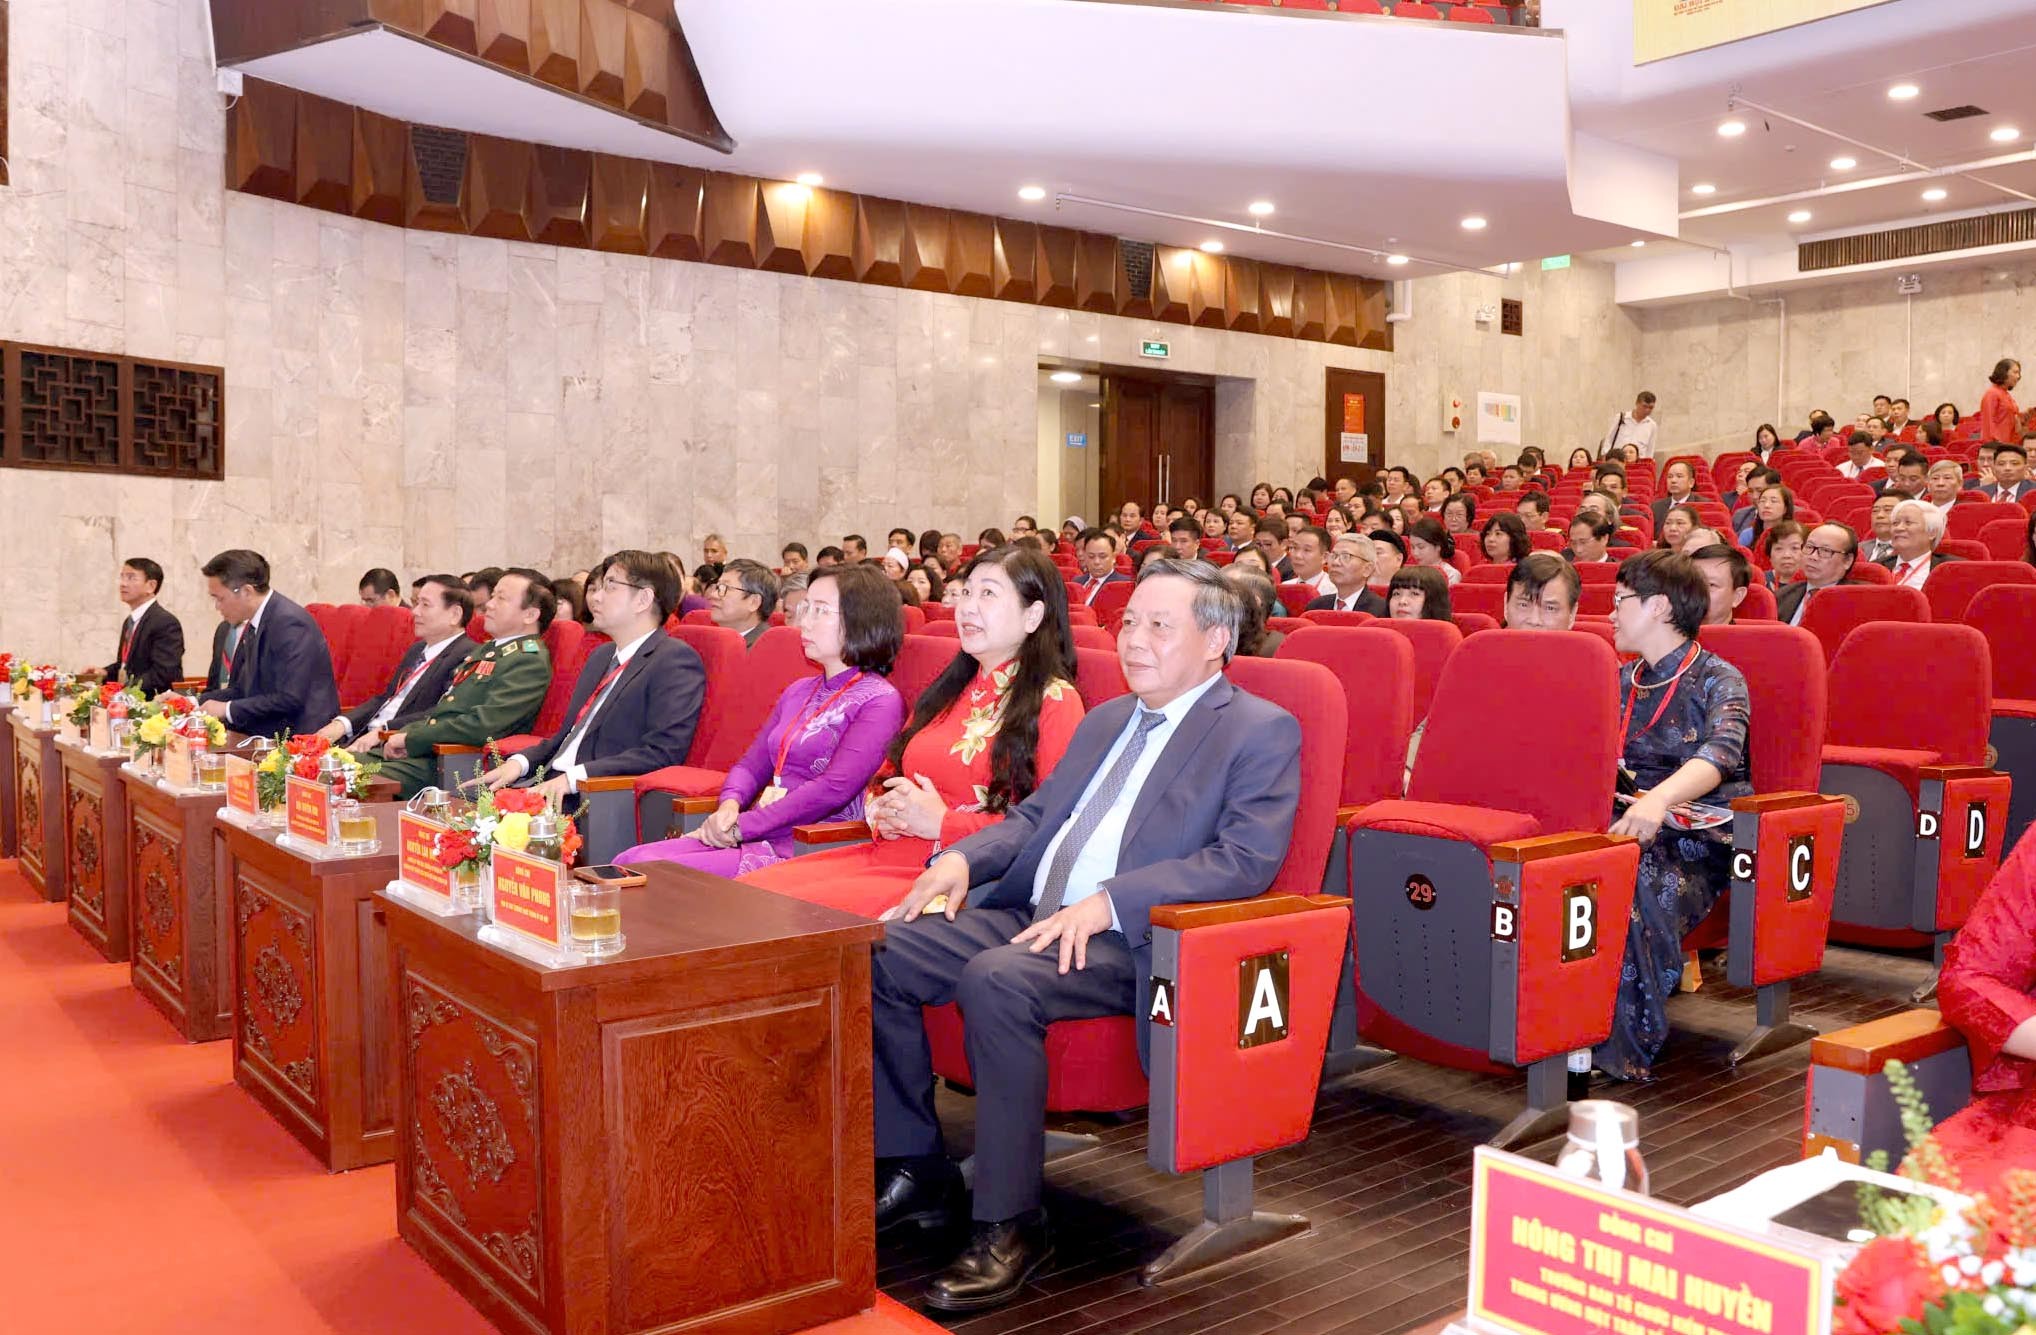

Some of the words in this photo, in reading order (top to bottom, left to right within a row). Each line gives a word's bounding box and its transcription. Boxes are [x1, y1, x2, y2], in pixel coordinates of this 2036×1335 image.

[1919, 813, 1938, 837] D
[1968, 809, 1985, 850] D
[1733, 853, 1752, 879] C
[1791, 844, 1811, 892] C
[1409, 881, 1432, 902] 29
[1495, 906, 1513, 936] B
[1568, 895, 1593, 951] B
[1151, 983, 1172, 1021] A
[1243, 968, 1284, 1036] A
[1512, 1215, 1576, 1264] NÔNG
[1581, 1238, 1623, 1286] THỊ
[1628, 1255, 1678, 1300] MAI
[1684, 1274, 1773, 1334] HUYỀN
